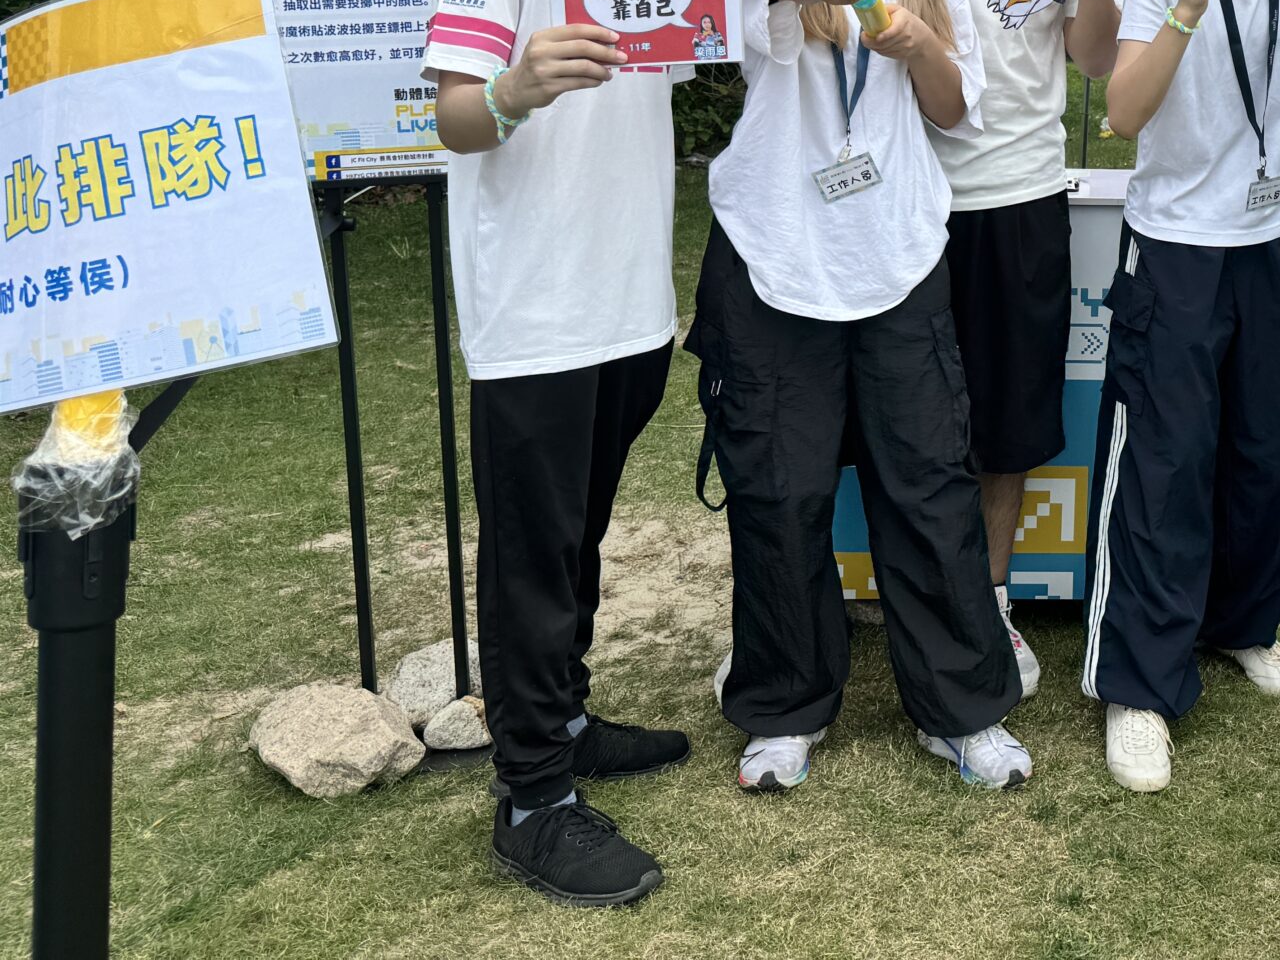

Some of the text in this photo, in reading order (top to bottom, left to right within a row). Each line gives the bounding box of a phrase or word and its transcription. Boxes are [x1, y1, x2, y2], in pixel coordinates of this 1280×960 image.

[286, 46, 426, 65] 之次數愈高愈好，並可獲
[395, 103, 436, 118] PLA
[4, 114, 267, 240] 此排隊!
